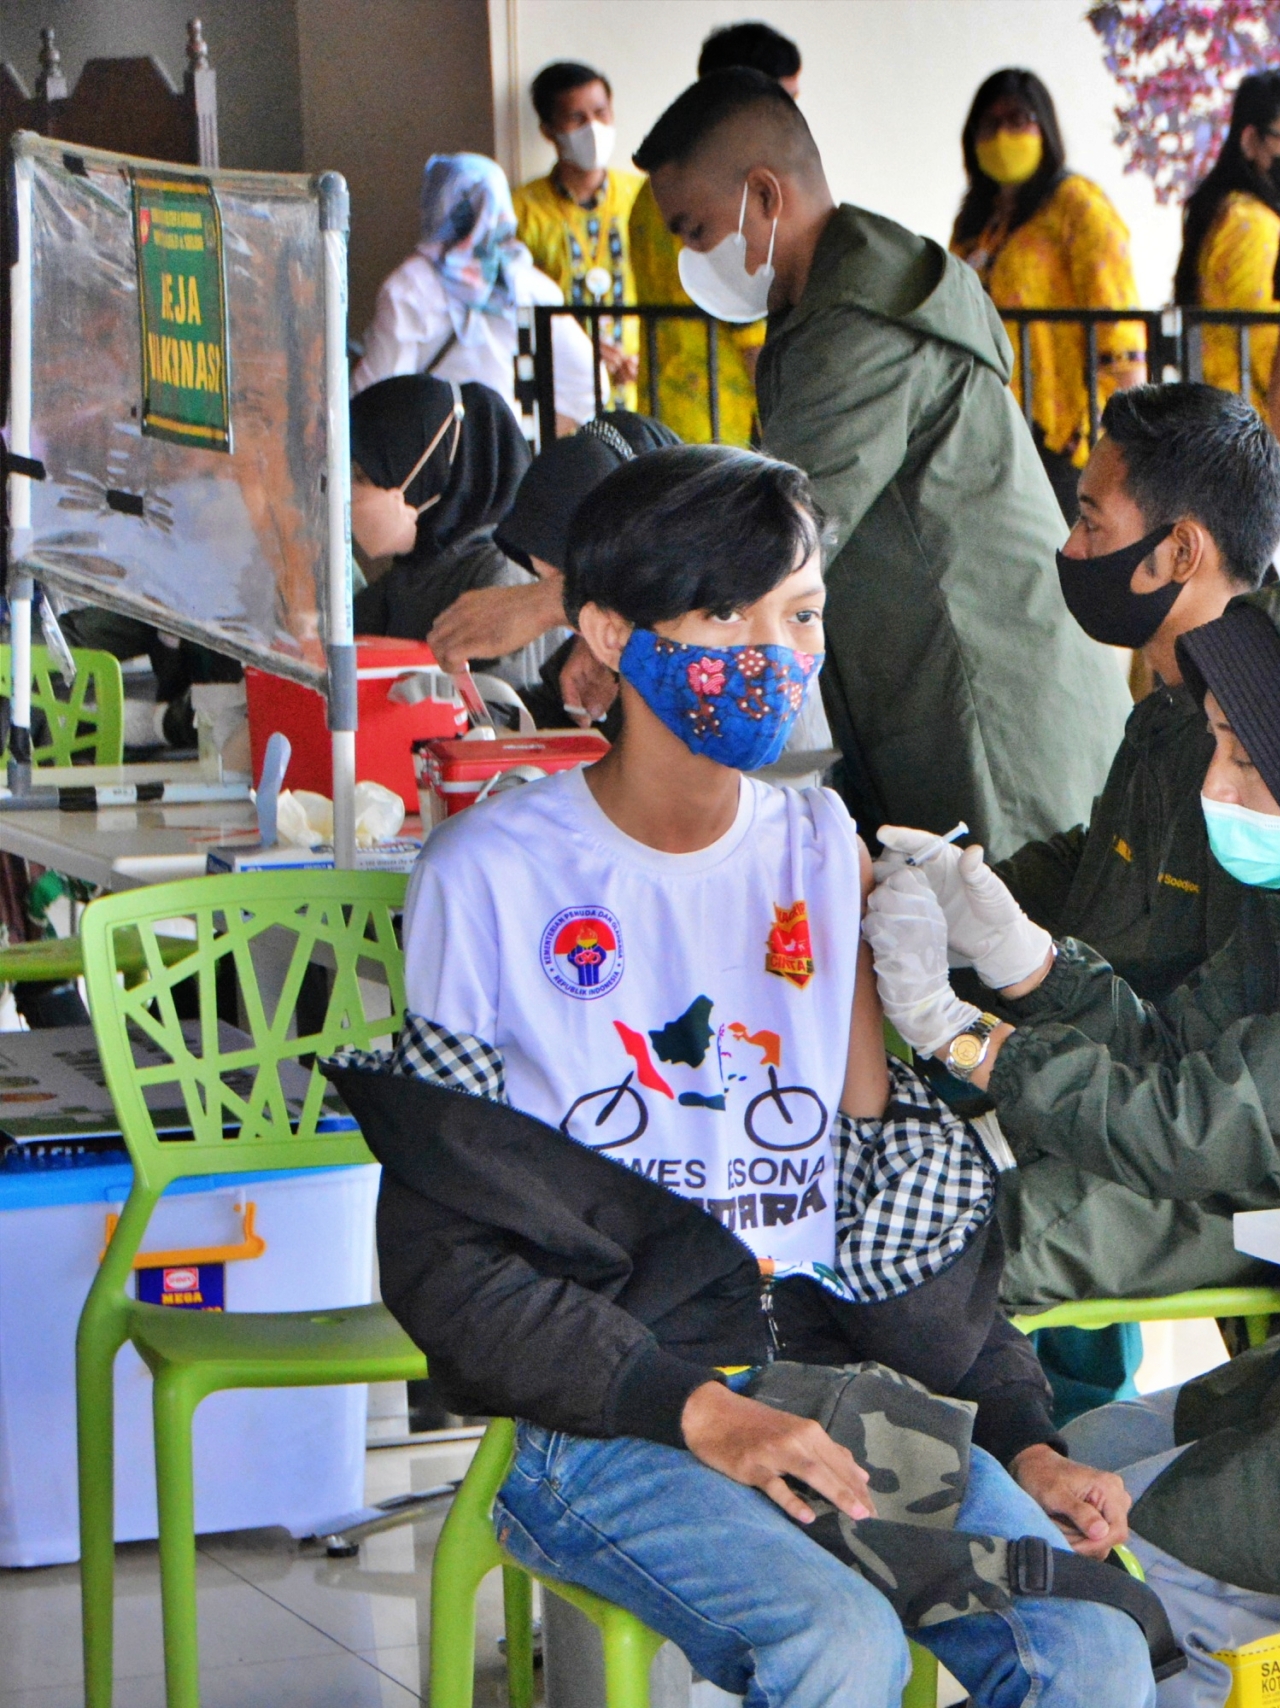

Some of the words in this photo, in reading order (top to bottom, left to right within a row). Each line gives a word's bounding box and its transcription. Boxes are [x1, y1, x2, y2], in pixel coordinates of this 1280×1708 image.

[543, 918, 566, 965] KEMENTERIAN
[597, 911, 613, 923] DAN
[553, 974, 587, 996] REPUBLIK
[588, 971, 620, 996] INDONESIA
